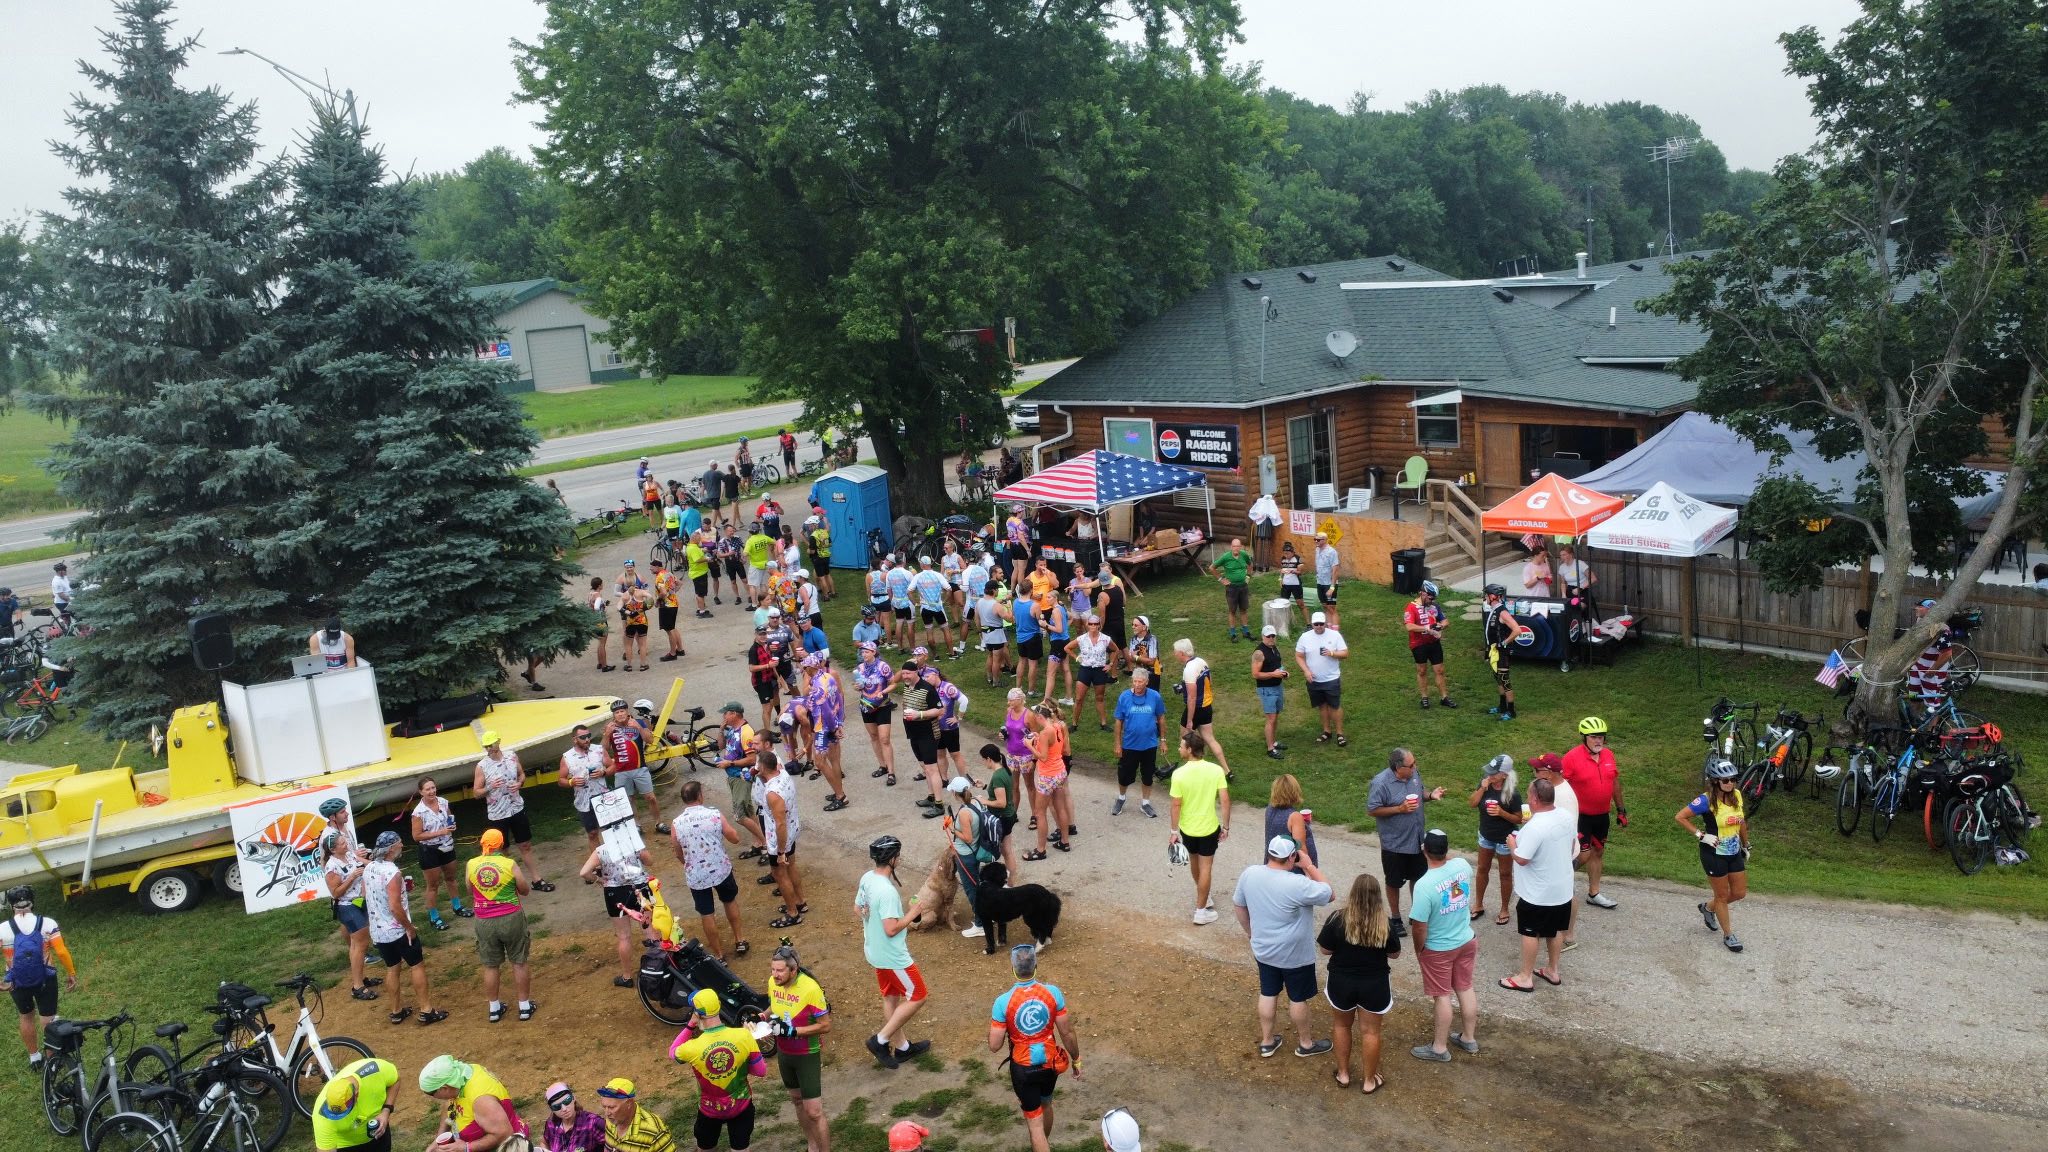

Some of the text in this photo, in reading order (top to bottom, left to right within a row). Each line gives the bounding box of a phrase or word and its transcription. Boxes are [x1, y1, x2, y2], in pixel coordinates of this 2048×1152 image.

[1189, 429, 1227, 439] WELCOME
[1160, 440, 1180, 448] PEPSI
[1186, 440, 1231, 452] RAGBRAI
[1190, 452, 1228, 464] RIDERS
[1526, 491, 1552, 509] G
[1646, 495, 1661, 508] G
[1628, 509, 1670, 522] ZERO
[1680, 502, 1702, 519] ZERO
[1292, 513, 1311, 523] LIVE
[1293, 522, 1312, 533] BAIT
[1508, 520, 1548, 528] GATORADE
[1608, 537, 1634, 546] ZERO
[1456, 871, 1467, 881] YOU
[773, 989, 784, 1000] TALL
[787, 993, 799, 1003] DOG
